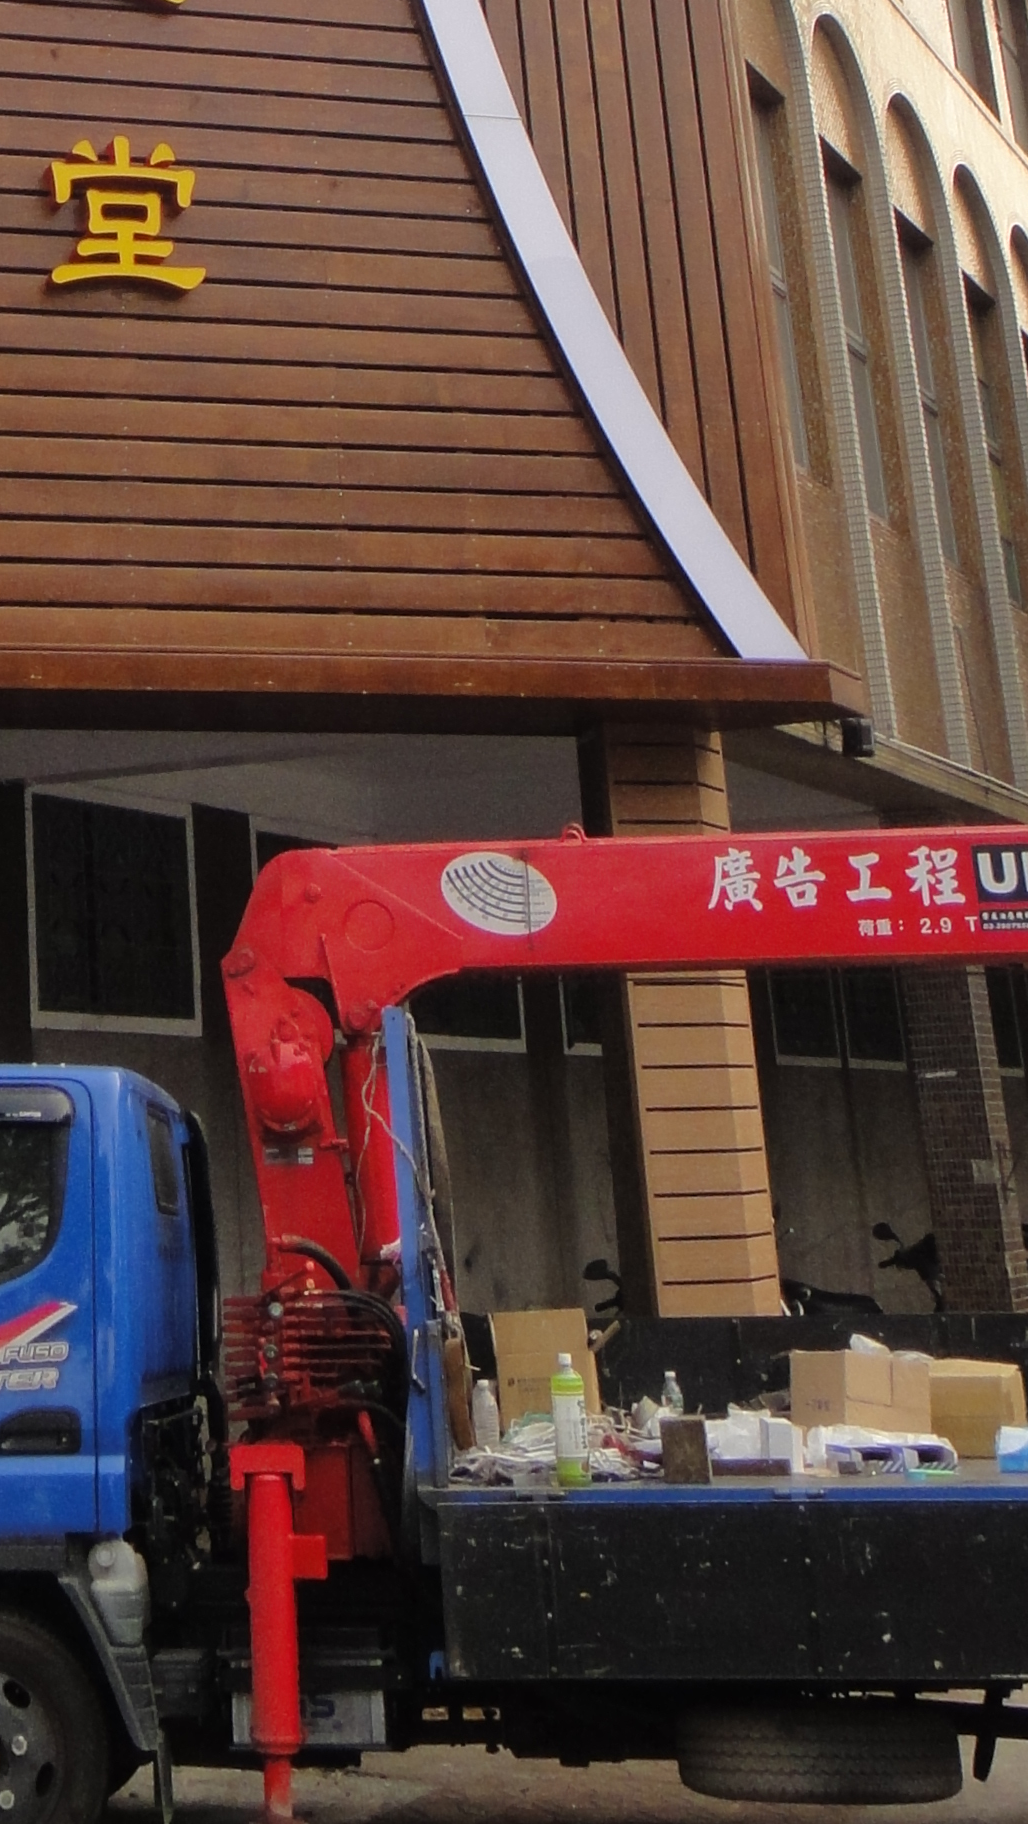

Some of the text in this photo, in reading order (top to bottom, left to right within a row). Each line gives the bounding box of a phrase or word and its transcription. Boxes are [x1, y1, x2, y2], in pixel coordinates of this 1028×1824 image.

[708, 846, 966, 911] 廣告工程
[1, 1341, 69, 1364] FUSO
